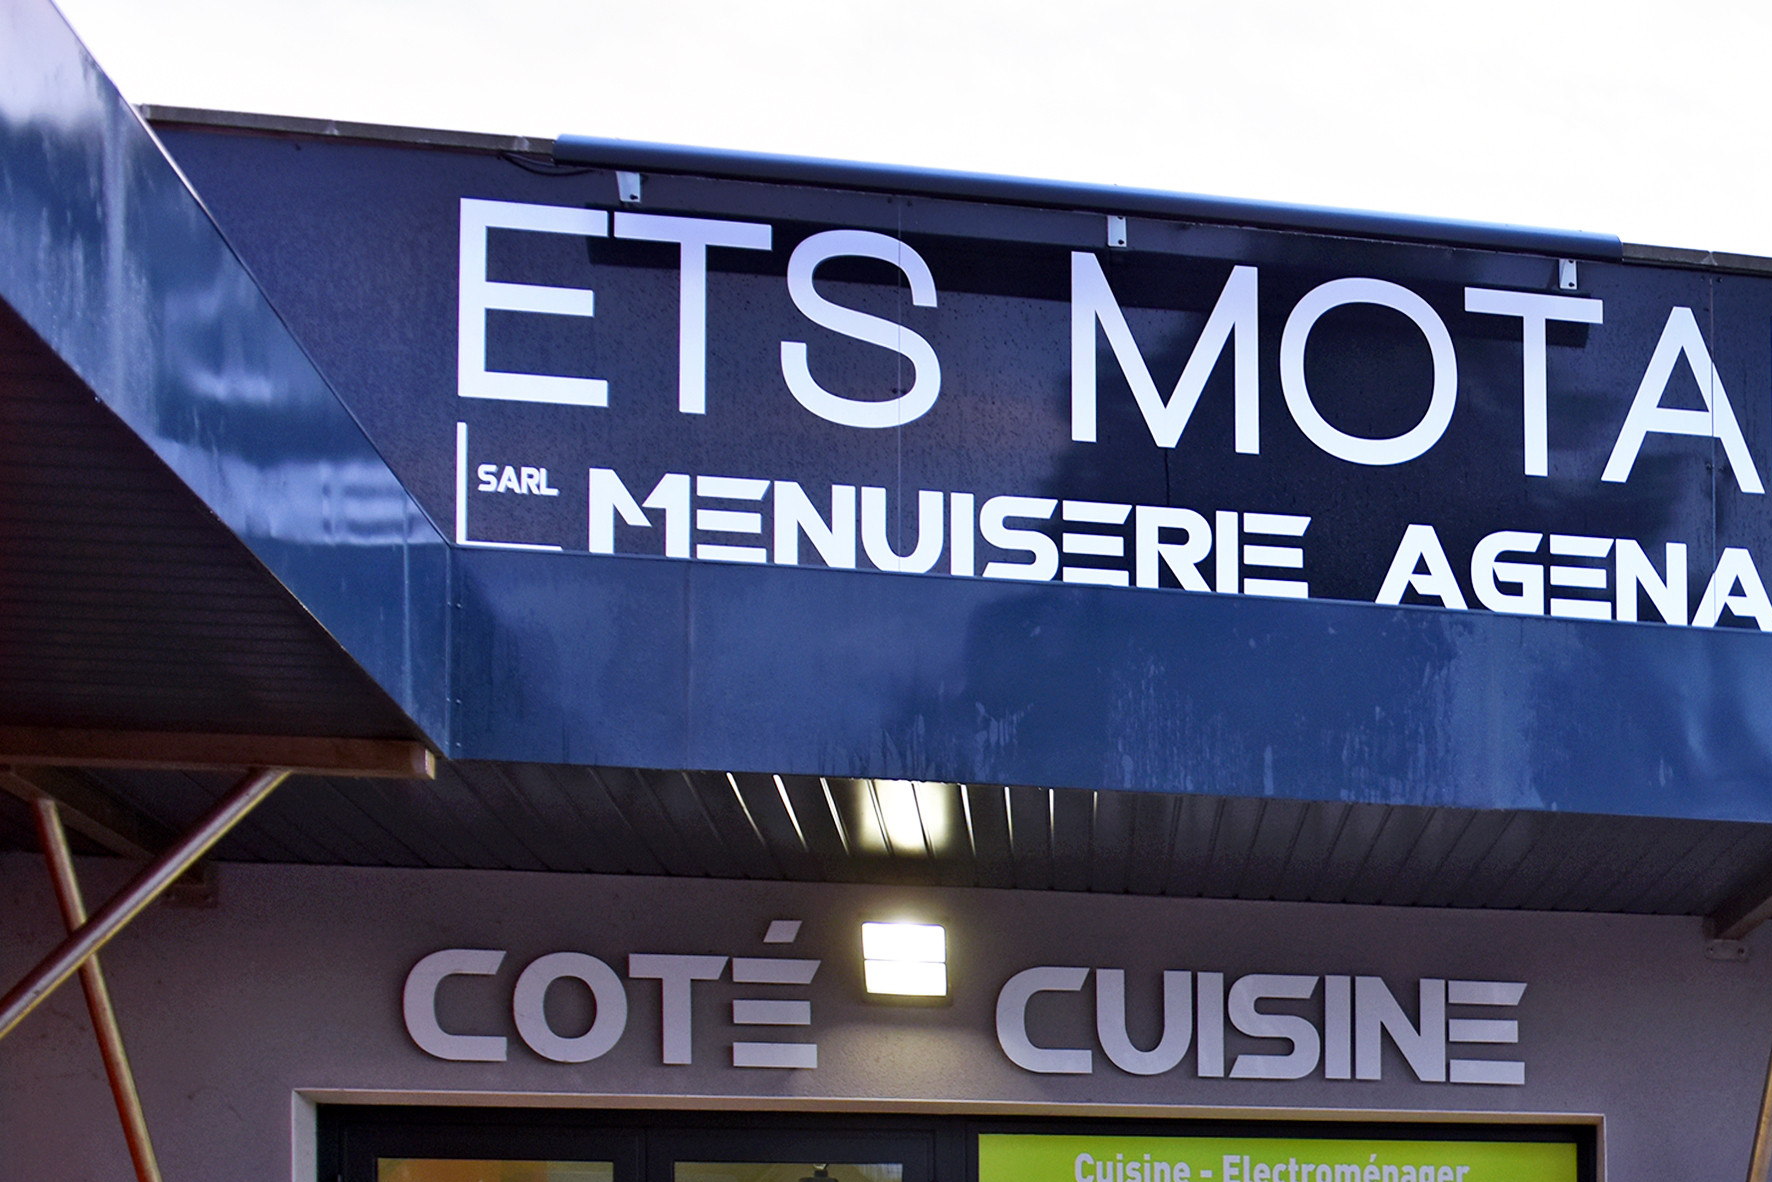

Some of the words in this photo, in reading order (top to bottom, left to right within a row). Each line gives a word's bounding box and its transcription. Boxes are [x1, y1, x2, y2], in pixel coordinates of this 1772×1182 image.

[458, 197, 942, 429] ETS
[477, 463, 559, 497] SARL
[588, 467, 1312, 600] MENUISERIE
[402, 920, 822, 1069] COTÉ
[996, 965, 1529, 1086] CUISINE
